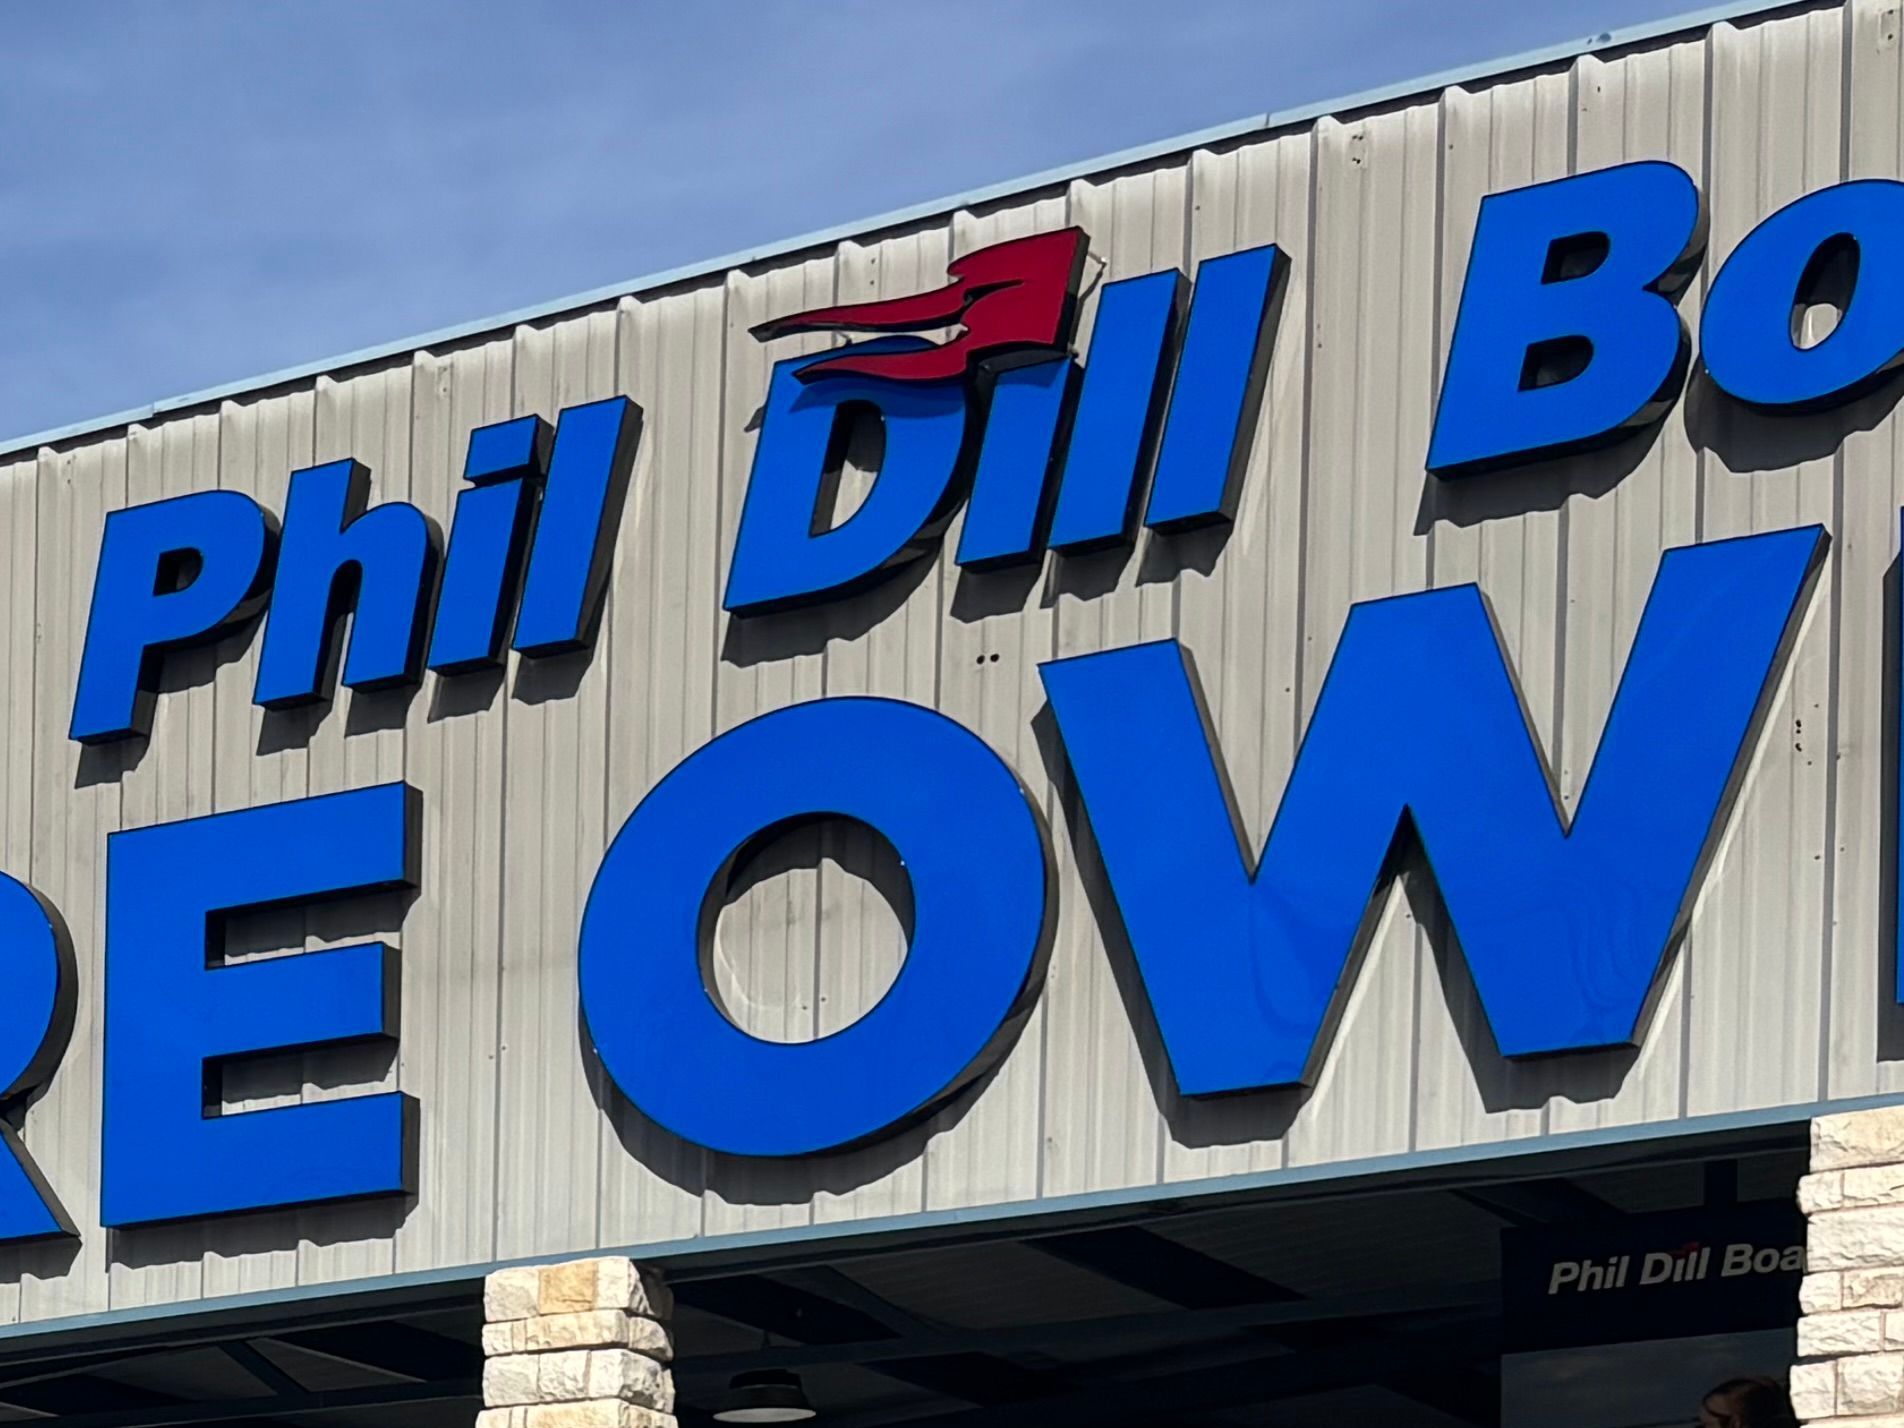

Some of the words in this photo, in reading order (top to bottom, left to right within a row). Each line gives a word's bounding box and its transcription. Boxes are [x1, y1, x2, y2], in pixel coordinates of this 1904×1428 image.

[72, 398, 626, 738] Phil
[726, 247, 1275, 607] Dill
[579, 526, 1904, 1156] OW
[1547, 1255, 1630, 1295] Phil
[1638, 1247, 1711, 1286] Dill
